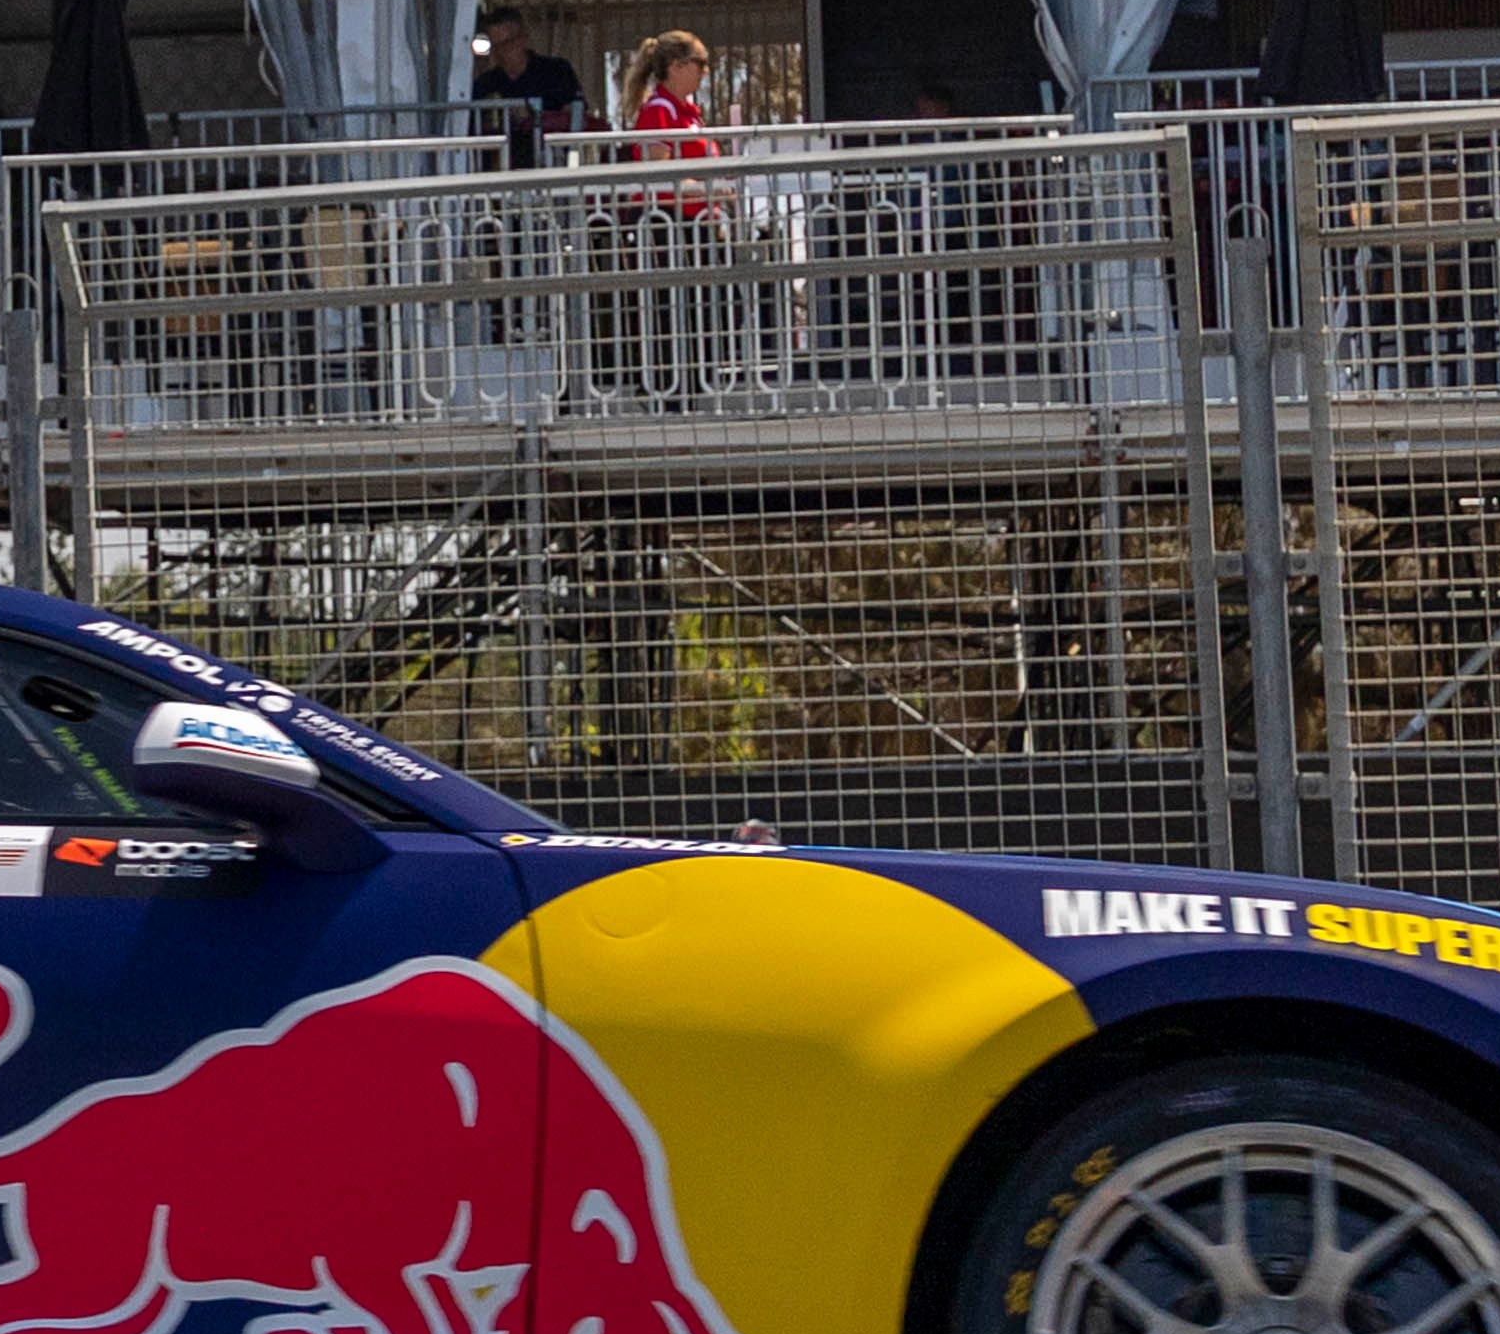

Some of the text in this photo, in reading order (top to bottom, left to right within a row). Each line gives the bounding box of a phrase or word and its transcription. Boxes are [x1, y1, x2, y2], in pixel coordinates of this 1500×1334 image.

[77, 620, 226, 686] AMPOL
[117, 839, 257, 862] boost
[538, 834, 788, 854] DUNLOP
[1041, 888, 1227, 938] MAKE
[1230, 896, 1298, 937] IT
